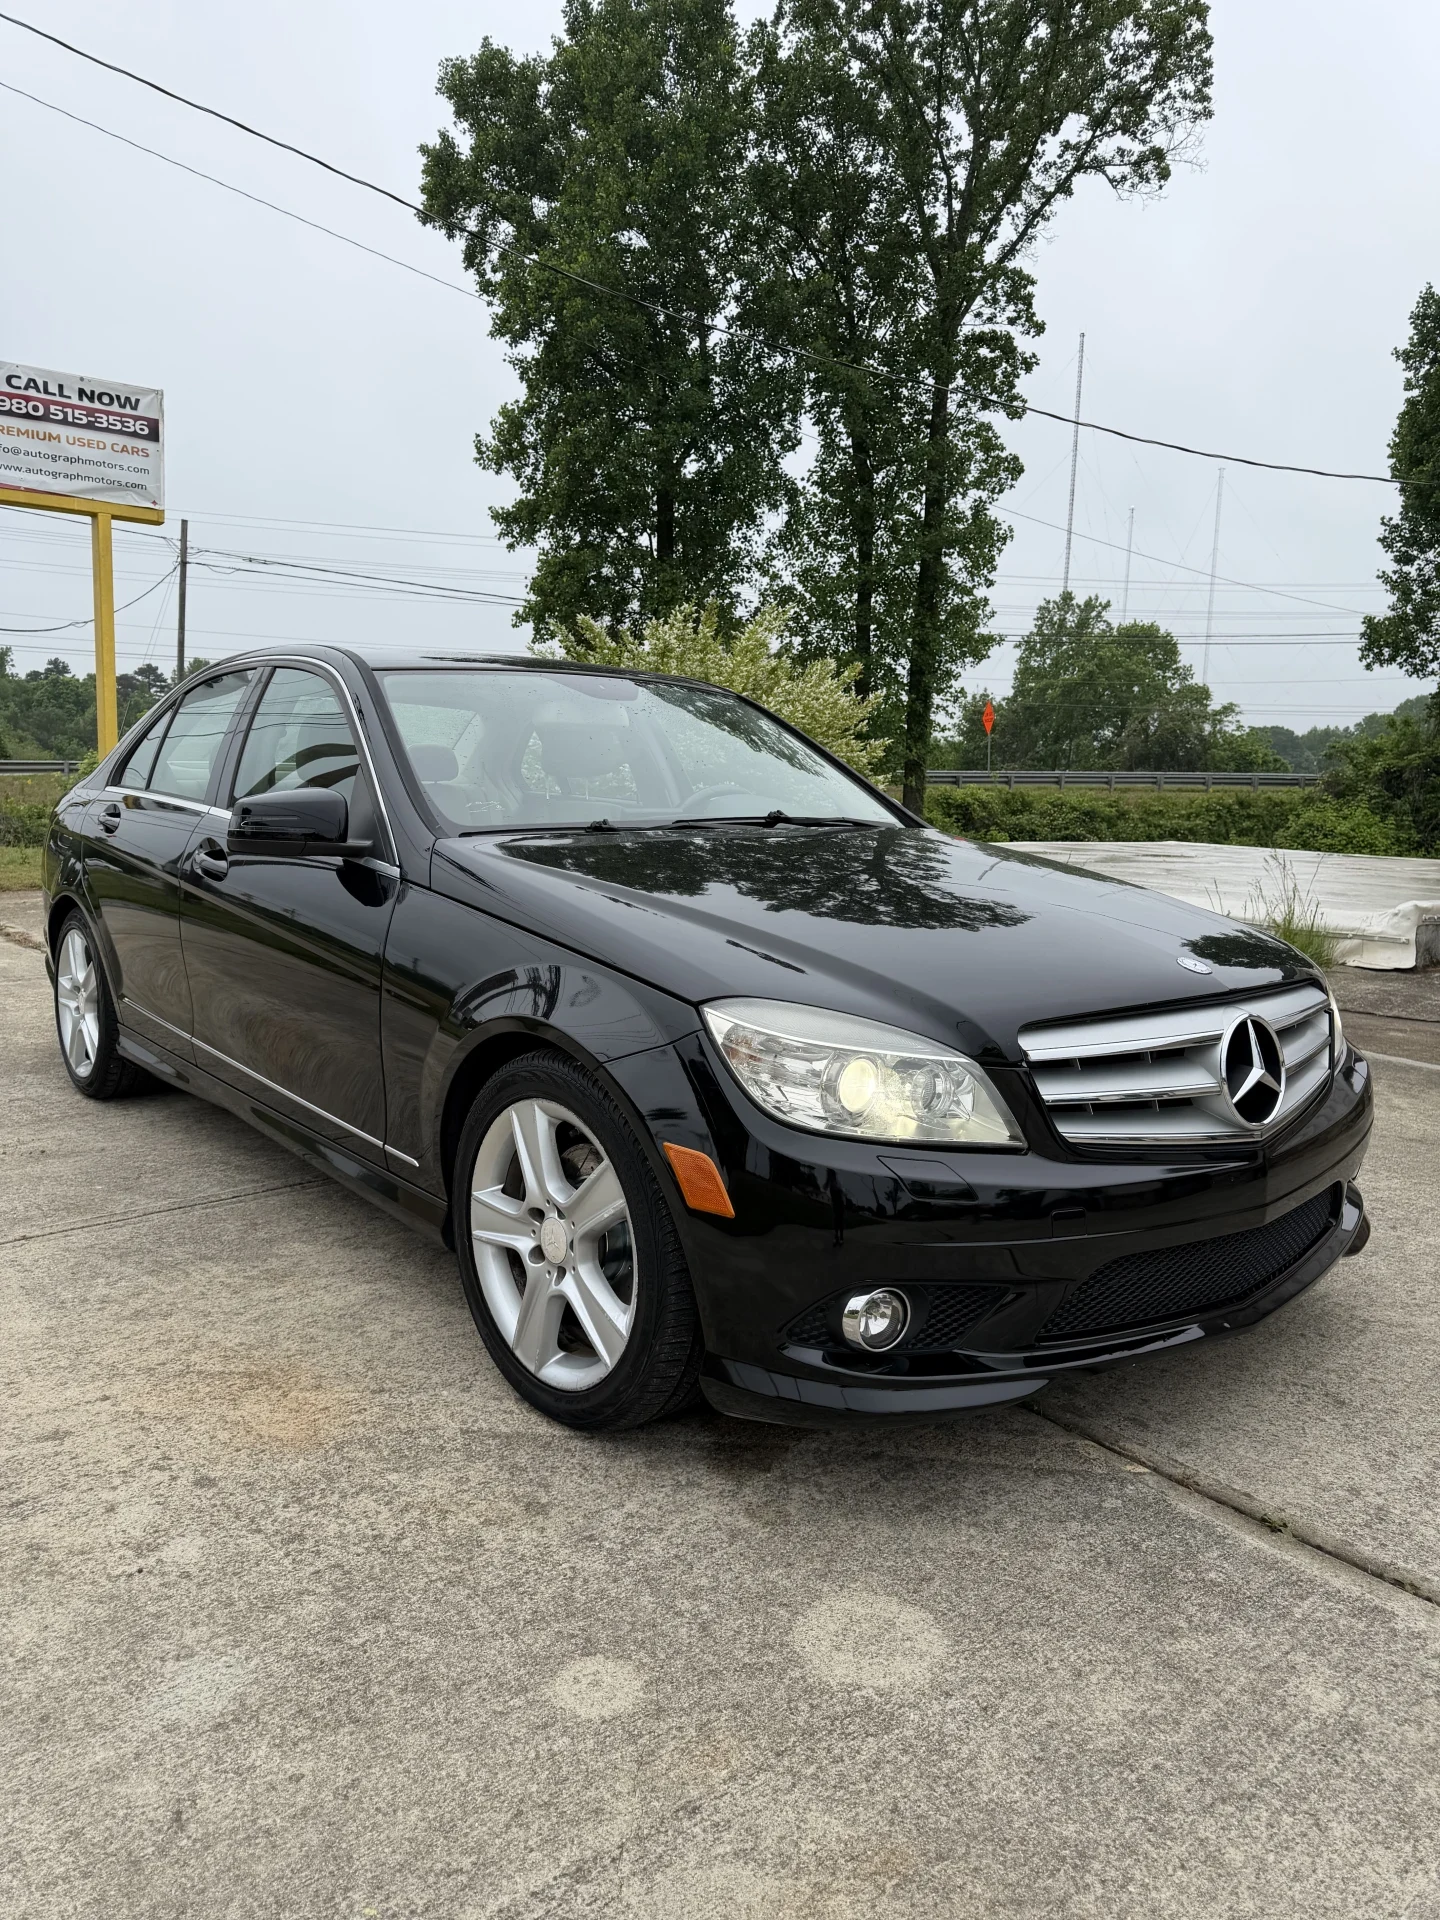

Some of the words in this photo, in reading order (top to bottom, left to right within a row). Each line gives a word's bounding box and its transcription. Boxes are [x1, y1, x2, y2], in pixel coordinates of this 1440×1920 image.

[5, 374, 73, 400] CALL
[77, 387, 141, 412] NOW
[0, 395, 44, 417] 980
[49, 405, 150, 435] 515-3536
[66, 434, 107, 450] USED
[111, 442, 150, 458] CARS
